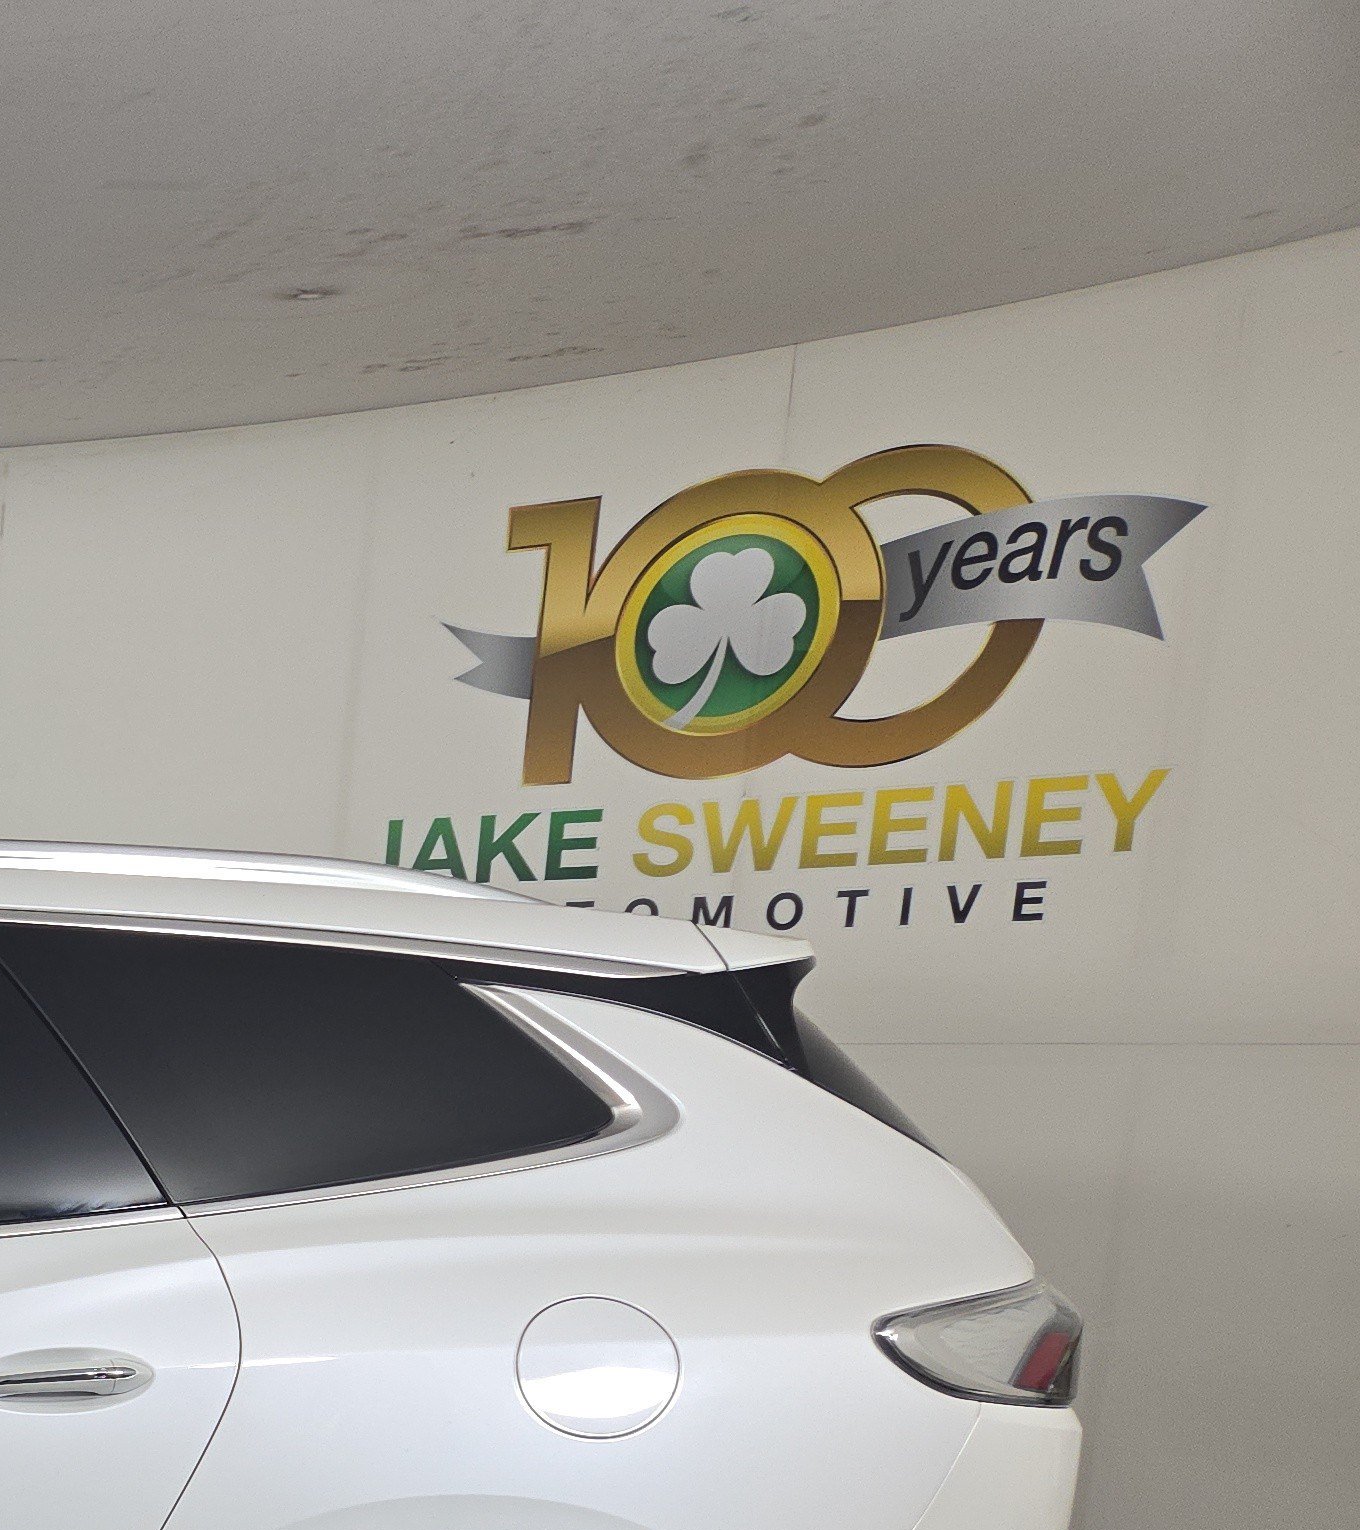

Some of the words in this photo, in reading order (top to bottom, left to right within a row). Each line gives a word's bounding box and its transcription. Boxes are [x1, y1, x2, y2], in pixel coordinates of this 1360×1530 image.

[507, 443, 1047, 787] 100
[898, 513, 1130, 621] years
[631, 768, 1172, 878] SWEENEY
[565, 880, 1049, 931] MOTIVE
